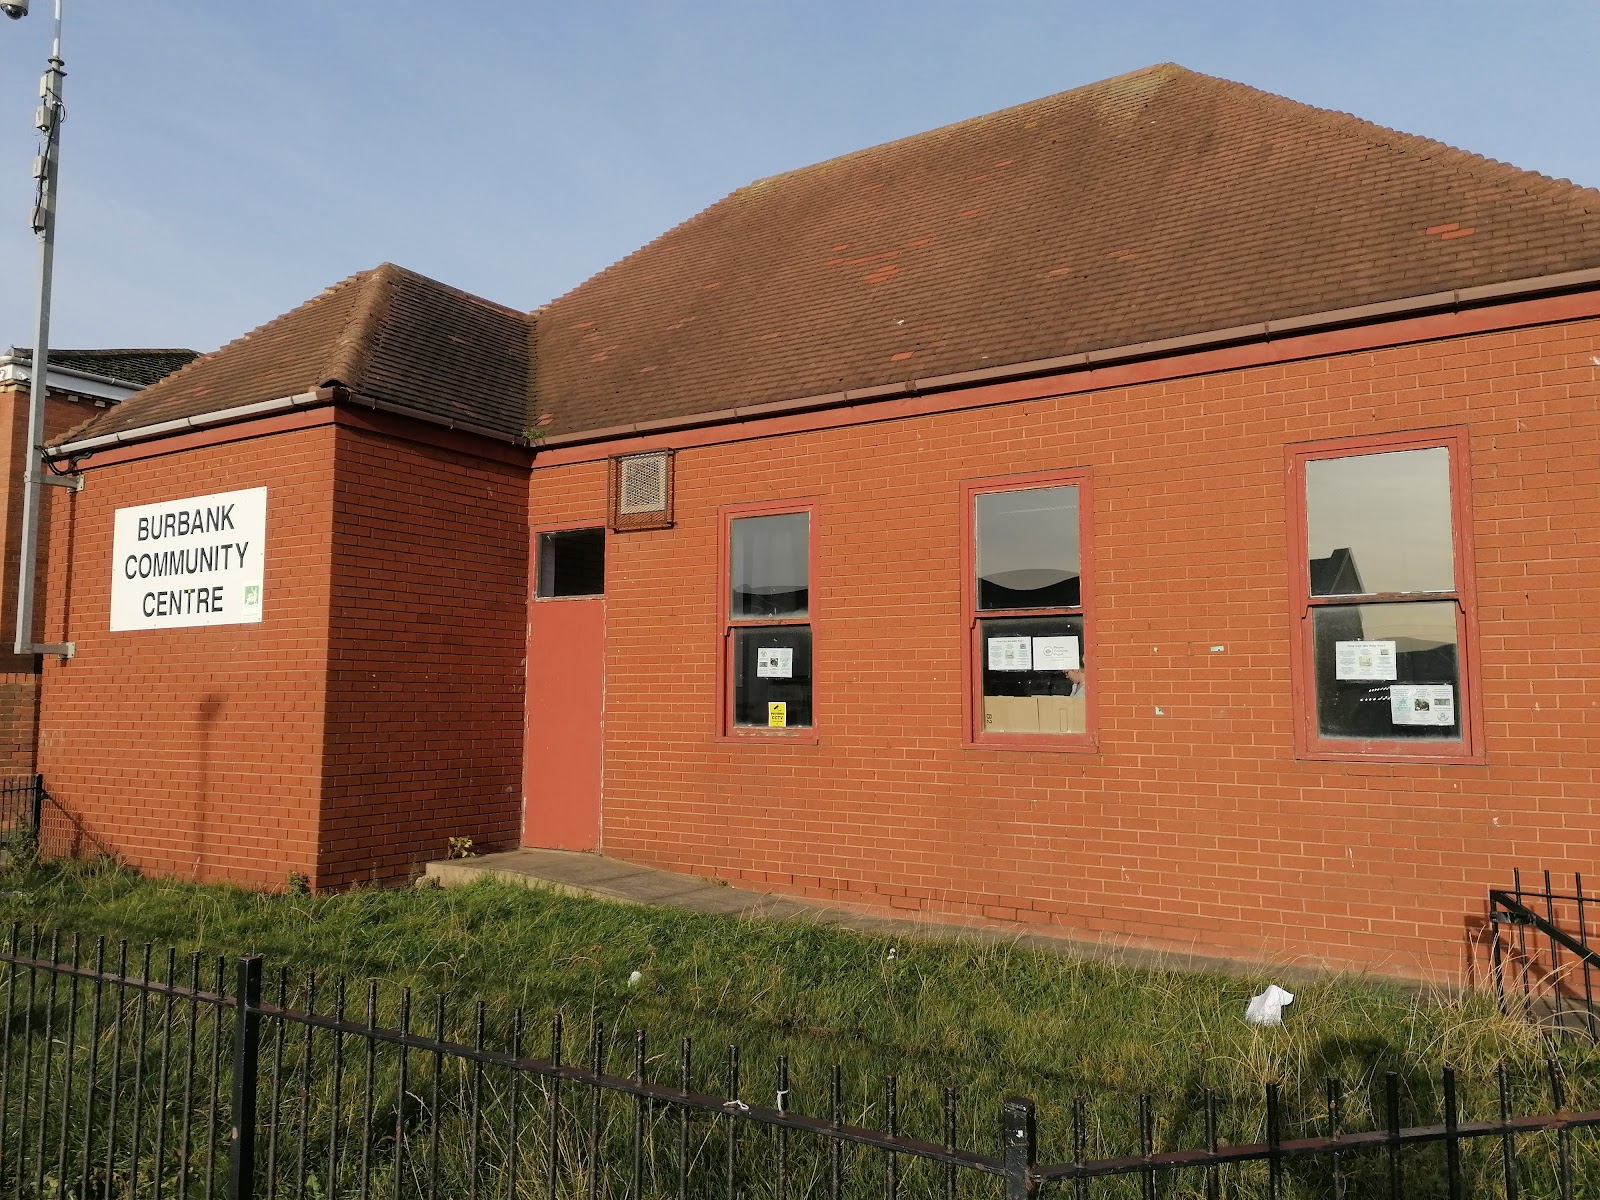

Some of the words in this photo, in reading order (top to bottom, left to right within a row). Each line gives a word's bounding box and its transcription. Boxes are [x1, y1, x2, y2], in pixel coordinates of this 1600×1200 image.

[138, 503, 235, 541] BURBANK
[125, 541, 249, 579] COMMUNITY
[143, 586, 223, 617] CENTRE
